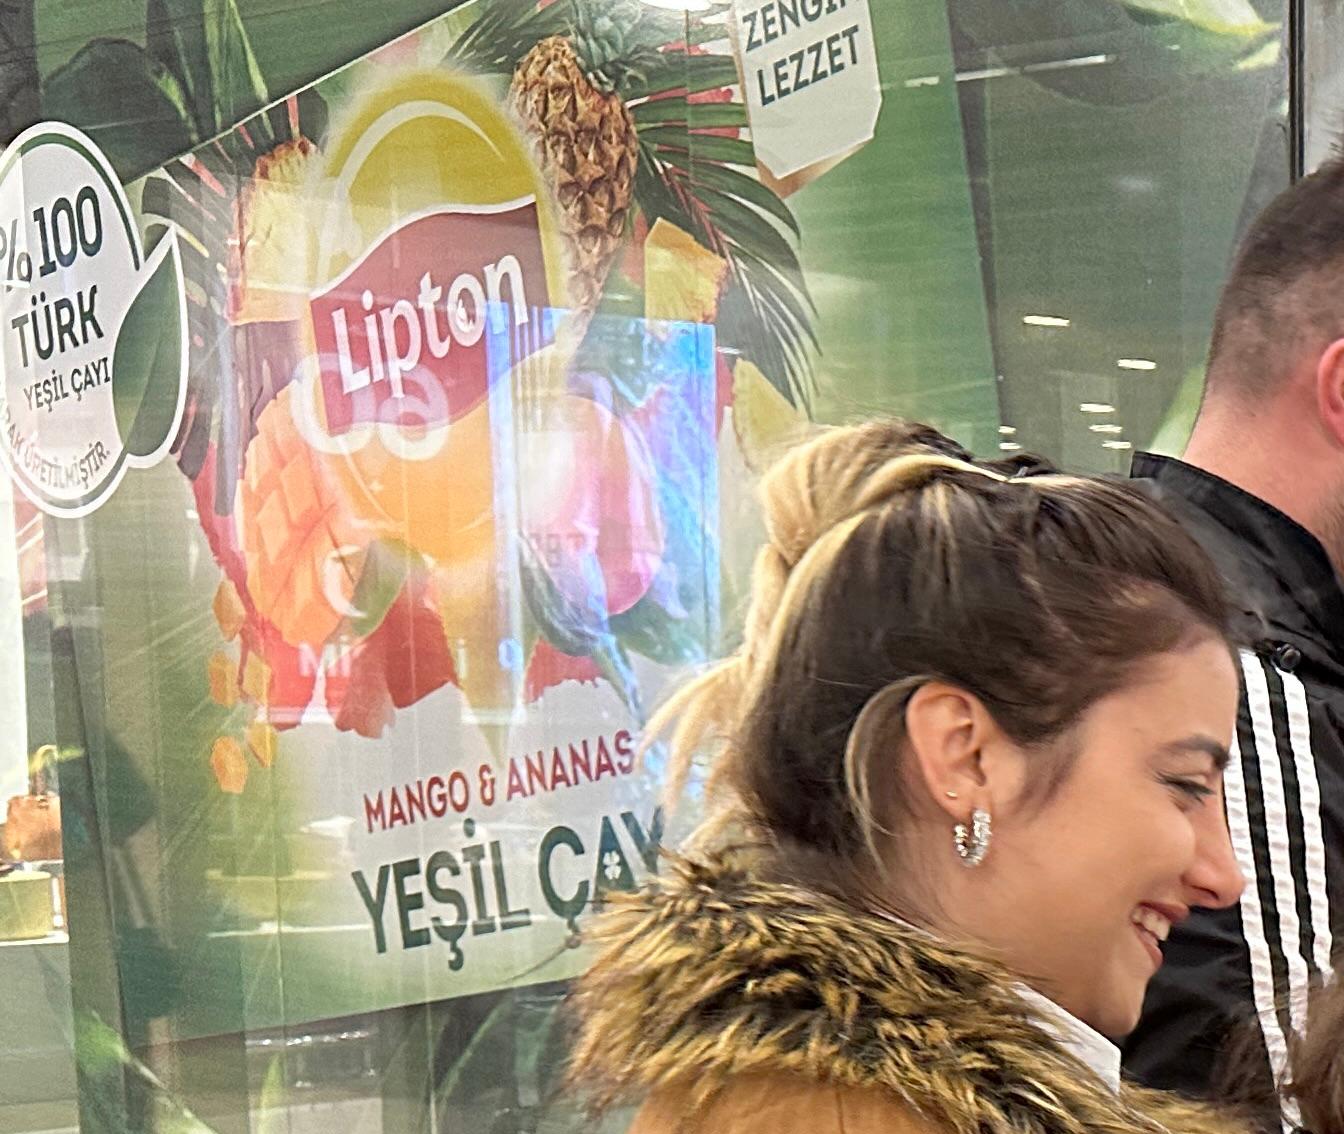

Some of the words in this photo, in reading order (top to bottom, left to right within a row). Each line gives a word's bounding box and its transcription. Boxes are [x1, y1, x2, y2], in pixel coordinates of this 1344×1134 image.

[757, 24, 859, 107] LEZZET
[12, 284, 104, 367] TÜRK
[331, 254, 529, 399] Lipton
[24, 369, 69, 412] YEŞİL
[71, 356, 111, 401] ÇAYI
[364, 770, 470, 834] MANGO
[478, 763, 496, 807] &
[506, 729, 635, 802] ANANAS
[352, 817, 532, 971] YEŞİL
